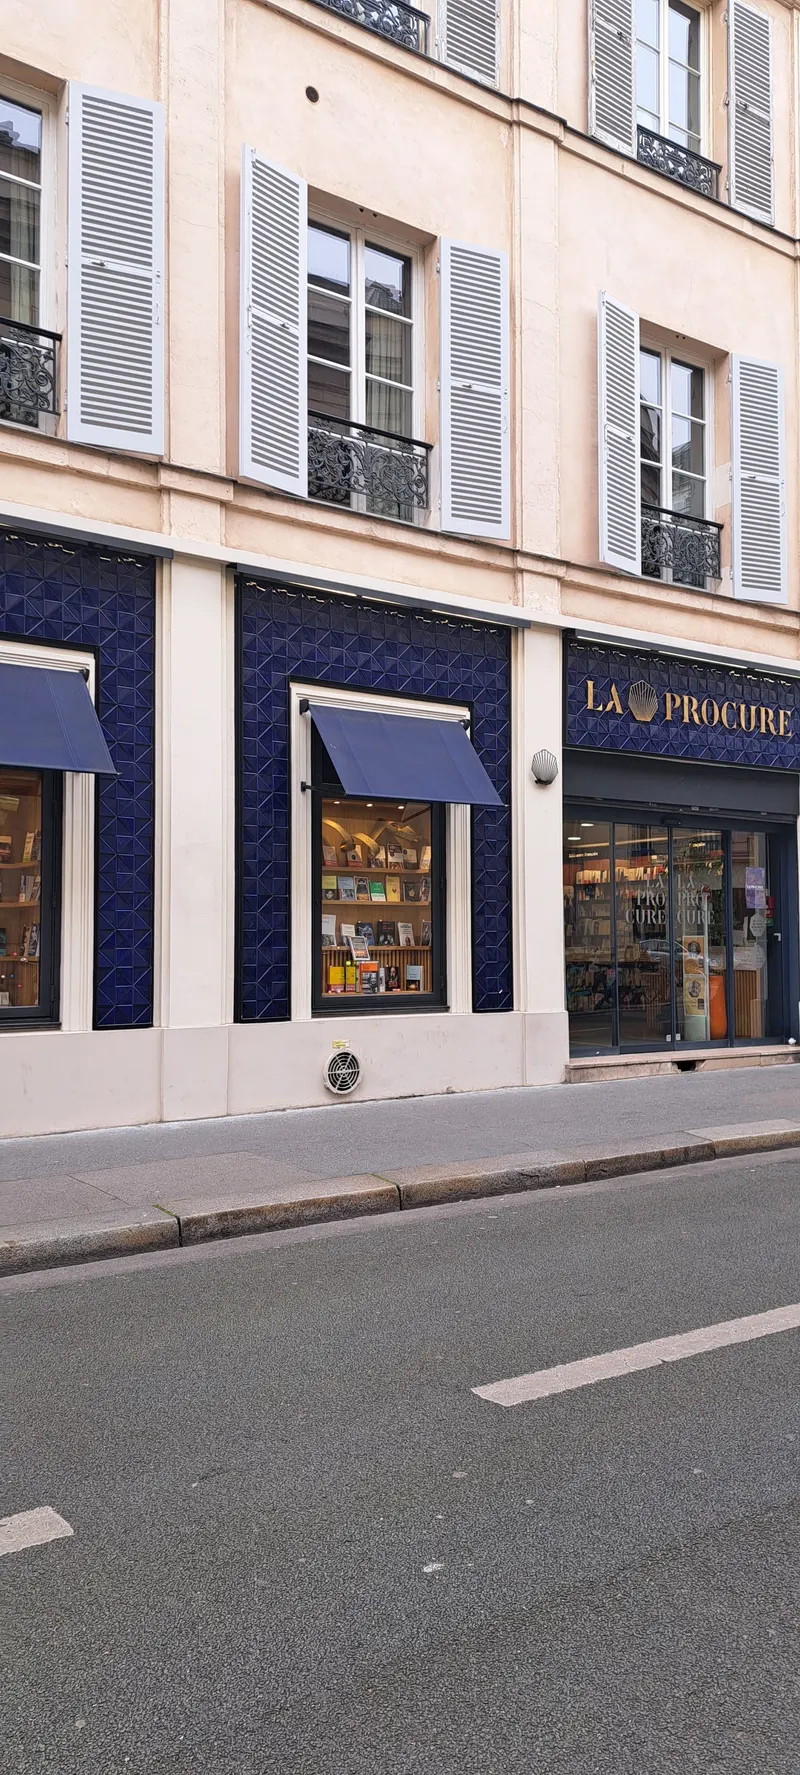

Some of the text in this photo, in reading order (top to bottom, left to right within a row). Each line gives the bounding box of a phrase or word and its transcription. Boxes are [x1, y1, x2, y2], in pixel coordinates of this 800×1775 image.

[585, 679, 792, 737] LA PROCURE
[637, 888, 666, 906] PRO
[625, 908, 666, 925] CURE
[676, 909, 715, 925] CURE
